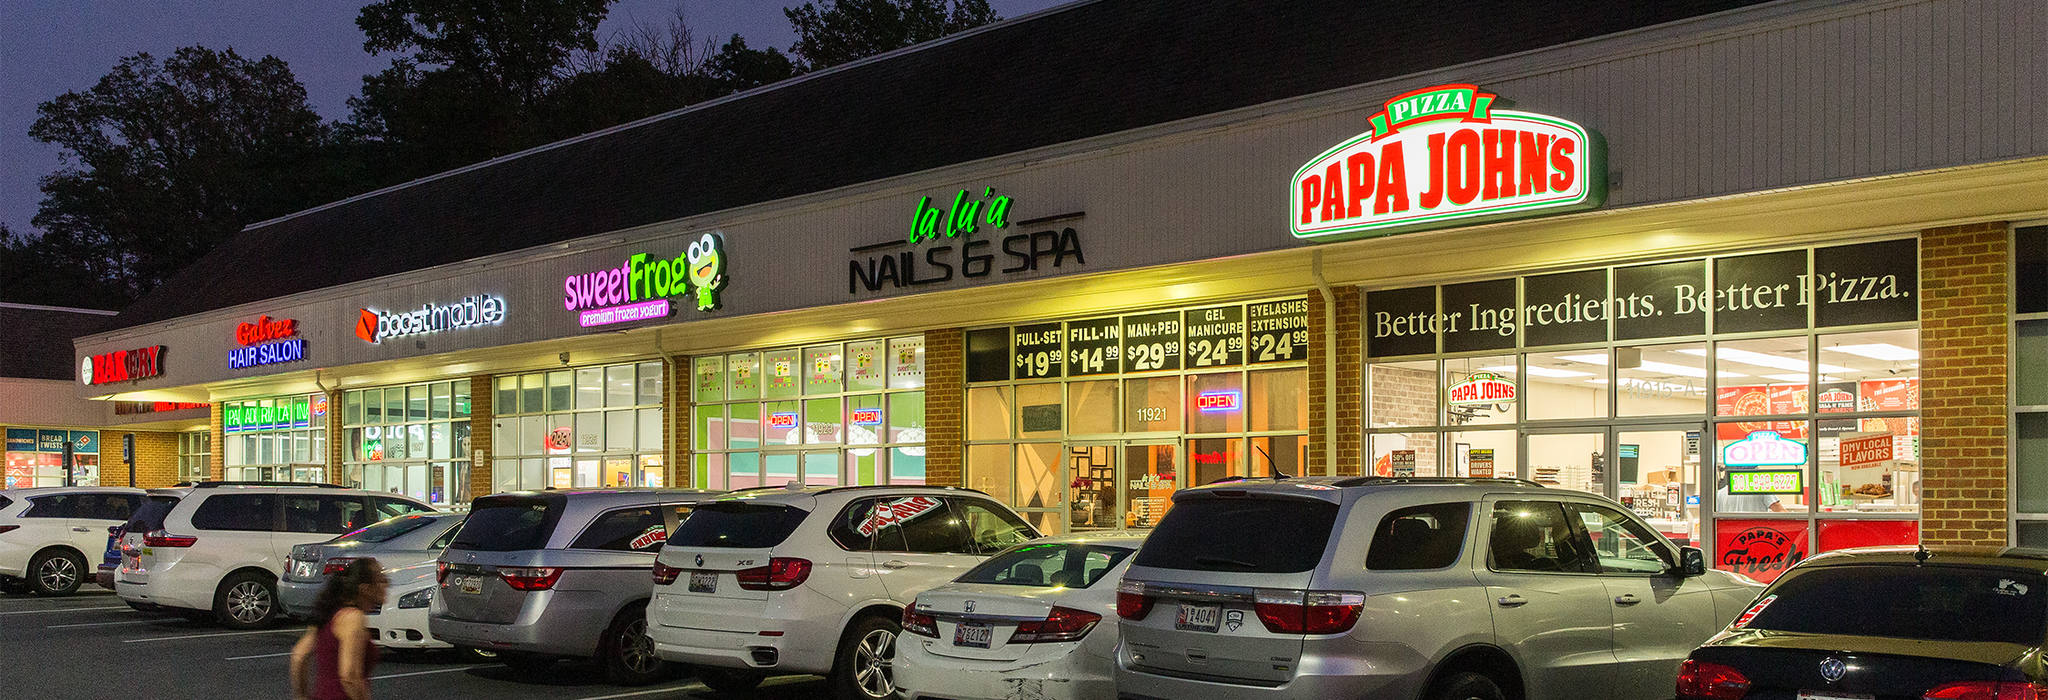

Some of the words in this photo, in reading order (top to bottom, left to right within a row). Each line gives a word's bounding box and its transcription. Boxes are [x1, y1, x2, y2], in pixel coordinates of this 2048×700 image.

[1394, 91, 1467, 123] PIZZA
[1301, 140, 1410, 224] PAPA
[1419, 128, 1575, 210] JOHN'S
[850, 246, 952, 294] NAILS
[961, 240, 994, 278] &
[1002, 227, 1085, 273] SPA
[565, 252, 687, 311] sweetFrog
[582, 312, 614, 325] premium
[615, 307, 639, 321] frozen
[640, 302, 666, 319] yogurt
[1251, 300, 1307, 317] EYELASHES
[1374, 311, 1462, 338] Better
[1674, 283, 1790, 315] Better
[1796, 272, 1909, 306] Pizza.
[1205, 309, 1225, 321] GEL
[1251, 315, 1307, 332] EXTENSION
[236, 314, 293, 345] Galvez
[1070, 325, 1119, 341] FILL-IN
[1128, 320, 1179, 338] MAN+PED
[1188, 321, 1242, 337] MANICURE
[228, 346, 257, 369] HAIR
[259, 338, 302, 365] SALON
[93, 344, 159, 384] BAKERY
[1451, 383, 1478, 401] PAPA
[1198, 394, 1236, 408] OPEN
[771, 415, 794, 425] OPEN
[853, 411, 878, 422] OPEN
[1136, 407, 1167, 421] 11921
[40, 441, 63, 449] TWISTS
[1730, 442, 1800, 461] OPEN
[1842, 442, 1861, 453] DMV
[1863, 438, 1892, 450] LOCAL
[1843, 448, 1890, 464] FLAVORS
[1739, 530, 1785, 545] PAPA'S
[1723, 543, 1804, 574] Fresh
